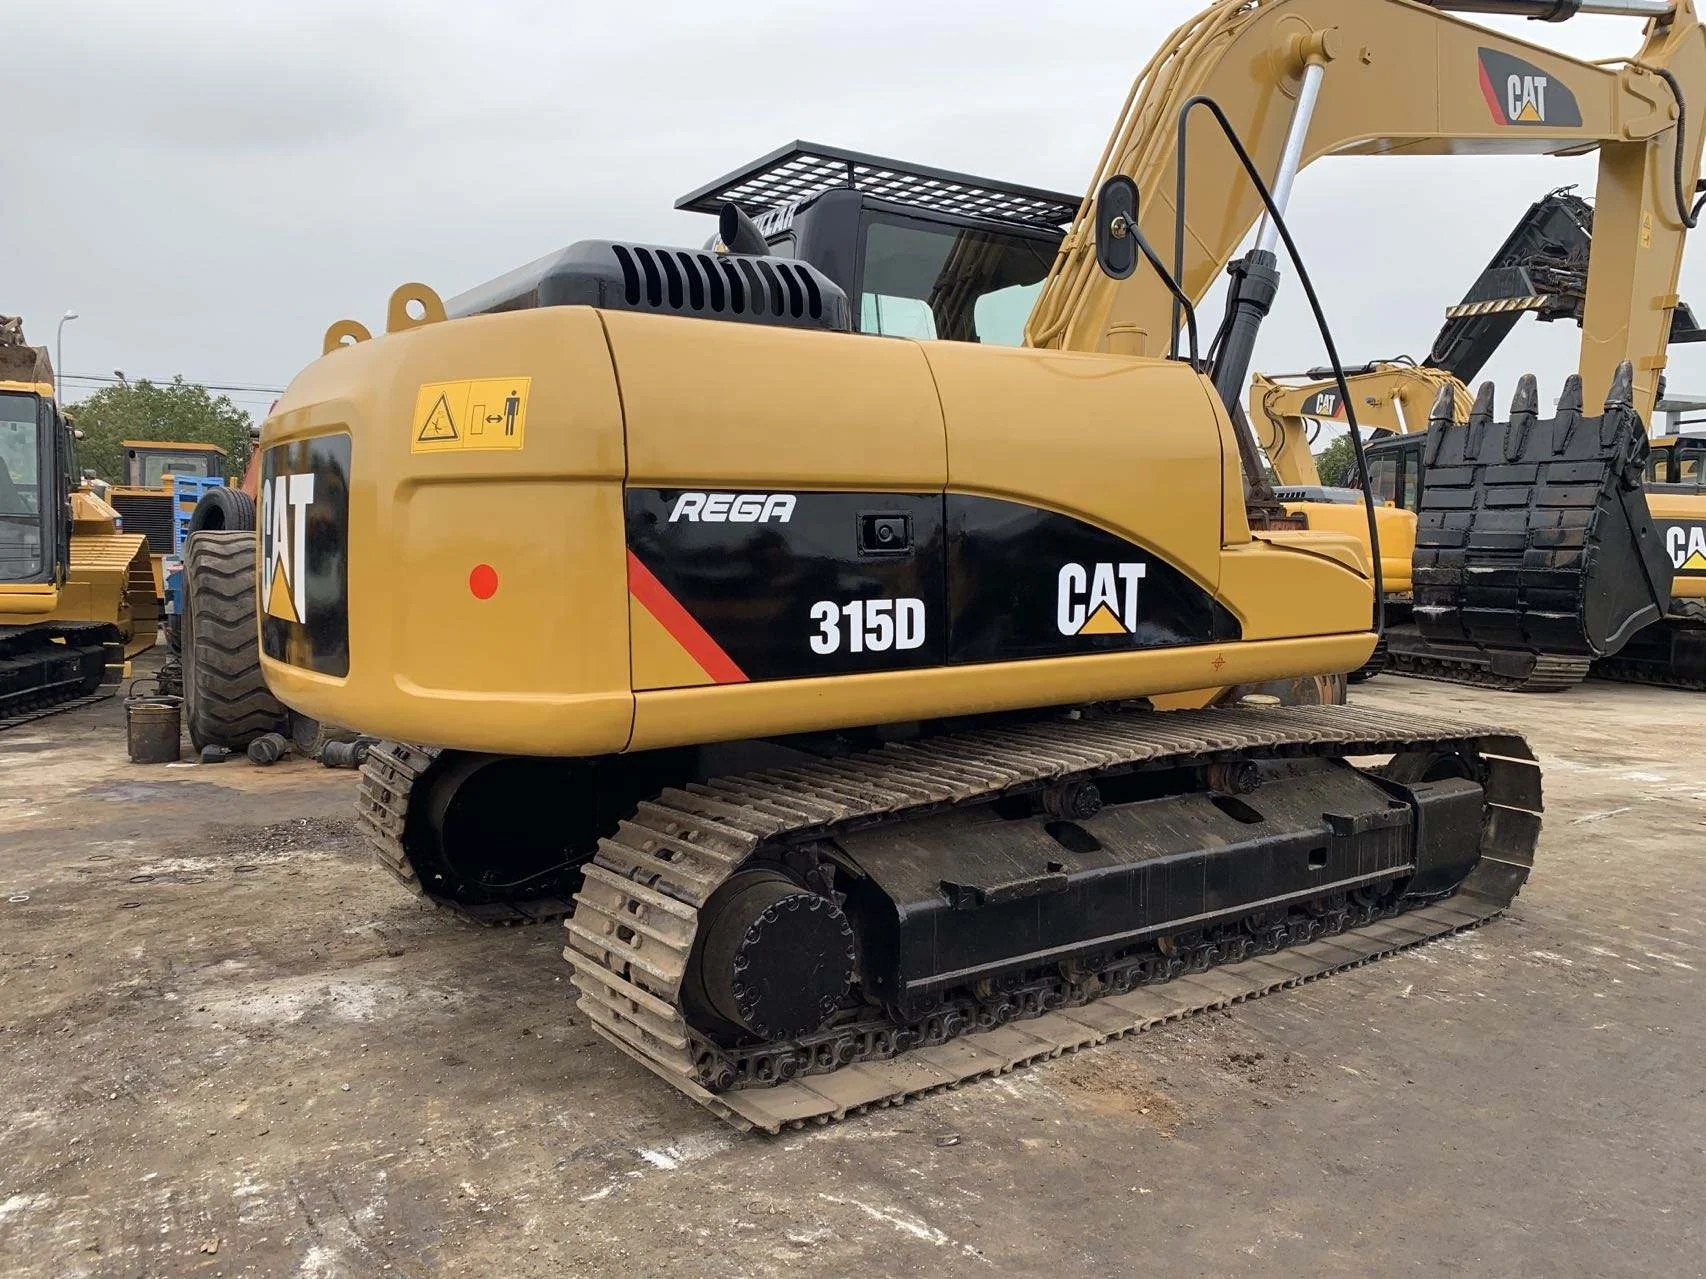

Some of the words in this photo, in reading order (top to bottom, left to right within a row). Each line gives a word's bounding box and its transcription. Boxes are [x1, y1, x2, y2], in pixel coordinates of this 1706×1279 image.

[1508, 75, 1546, 121] CAT
[1315, 393, 1336, 416] CAT
[669, 493, 796, 522] REGA
[261, 473, 314, 624] CAT
[1667, 527, 1706, 569] CA
[1058, 563, 1145, 635] CAT
[810, 598, 925, 654] 315D
